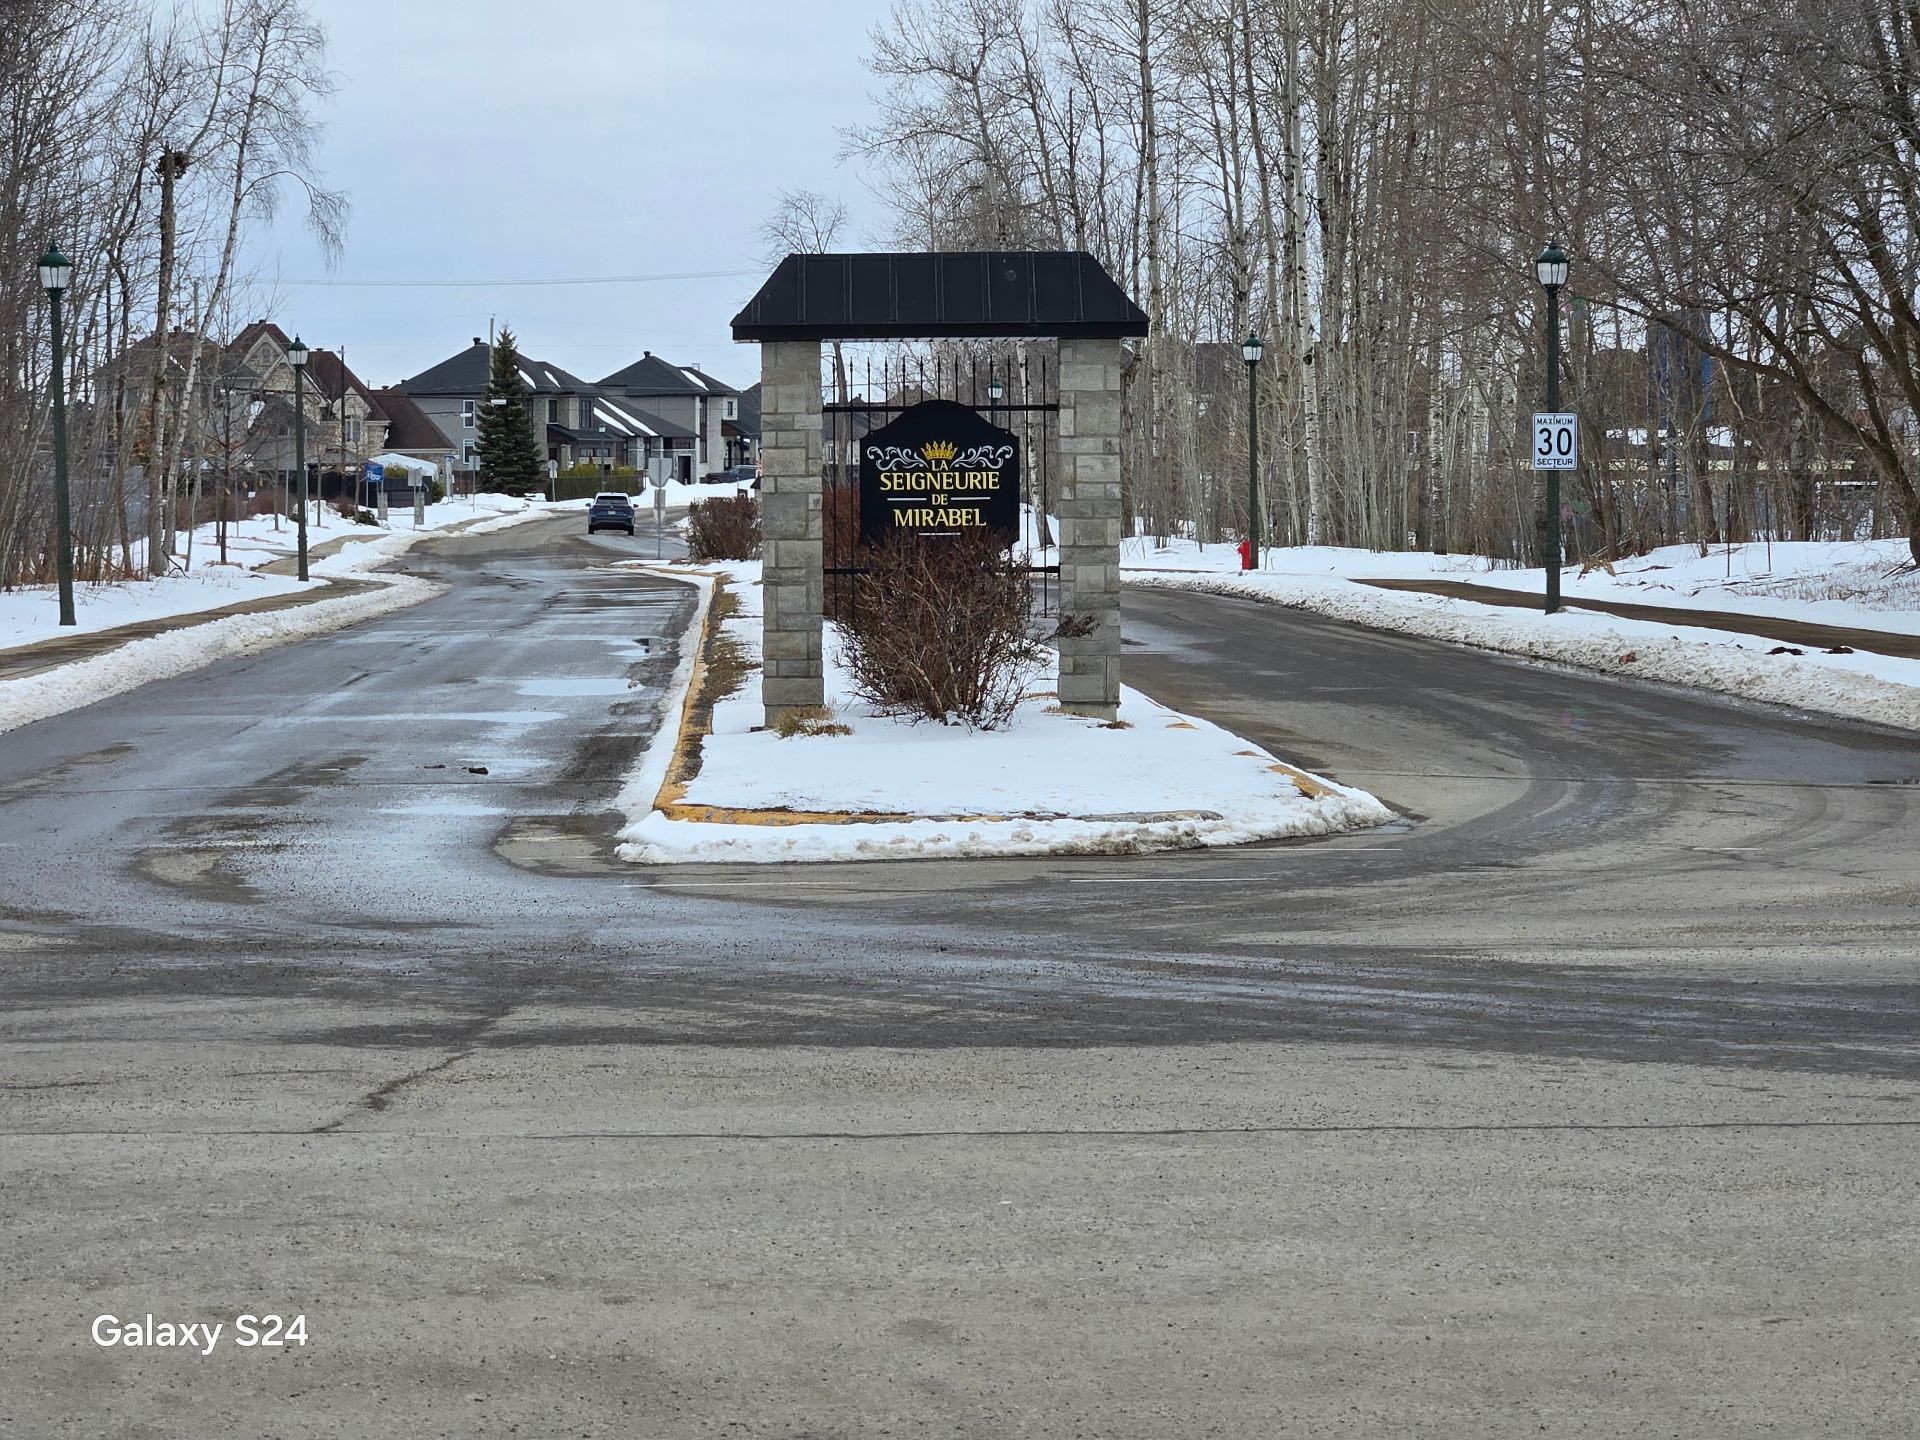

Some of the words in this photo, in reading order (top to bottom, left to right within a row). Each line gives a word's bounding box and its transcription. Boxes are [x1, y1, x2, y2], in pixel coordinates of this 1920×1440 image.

[1538, 428, 1572, 455] 30
[931, 460, 949, 471] LA
[880, 472, 1000, 491] SEIGNEURIE
[932, 494, 948, 505] DE
[893, 508, 987, 527] MIRABEL
